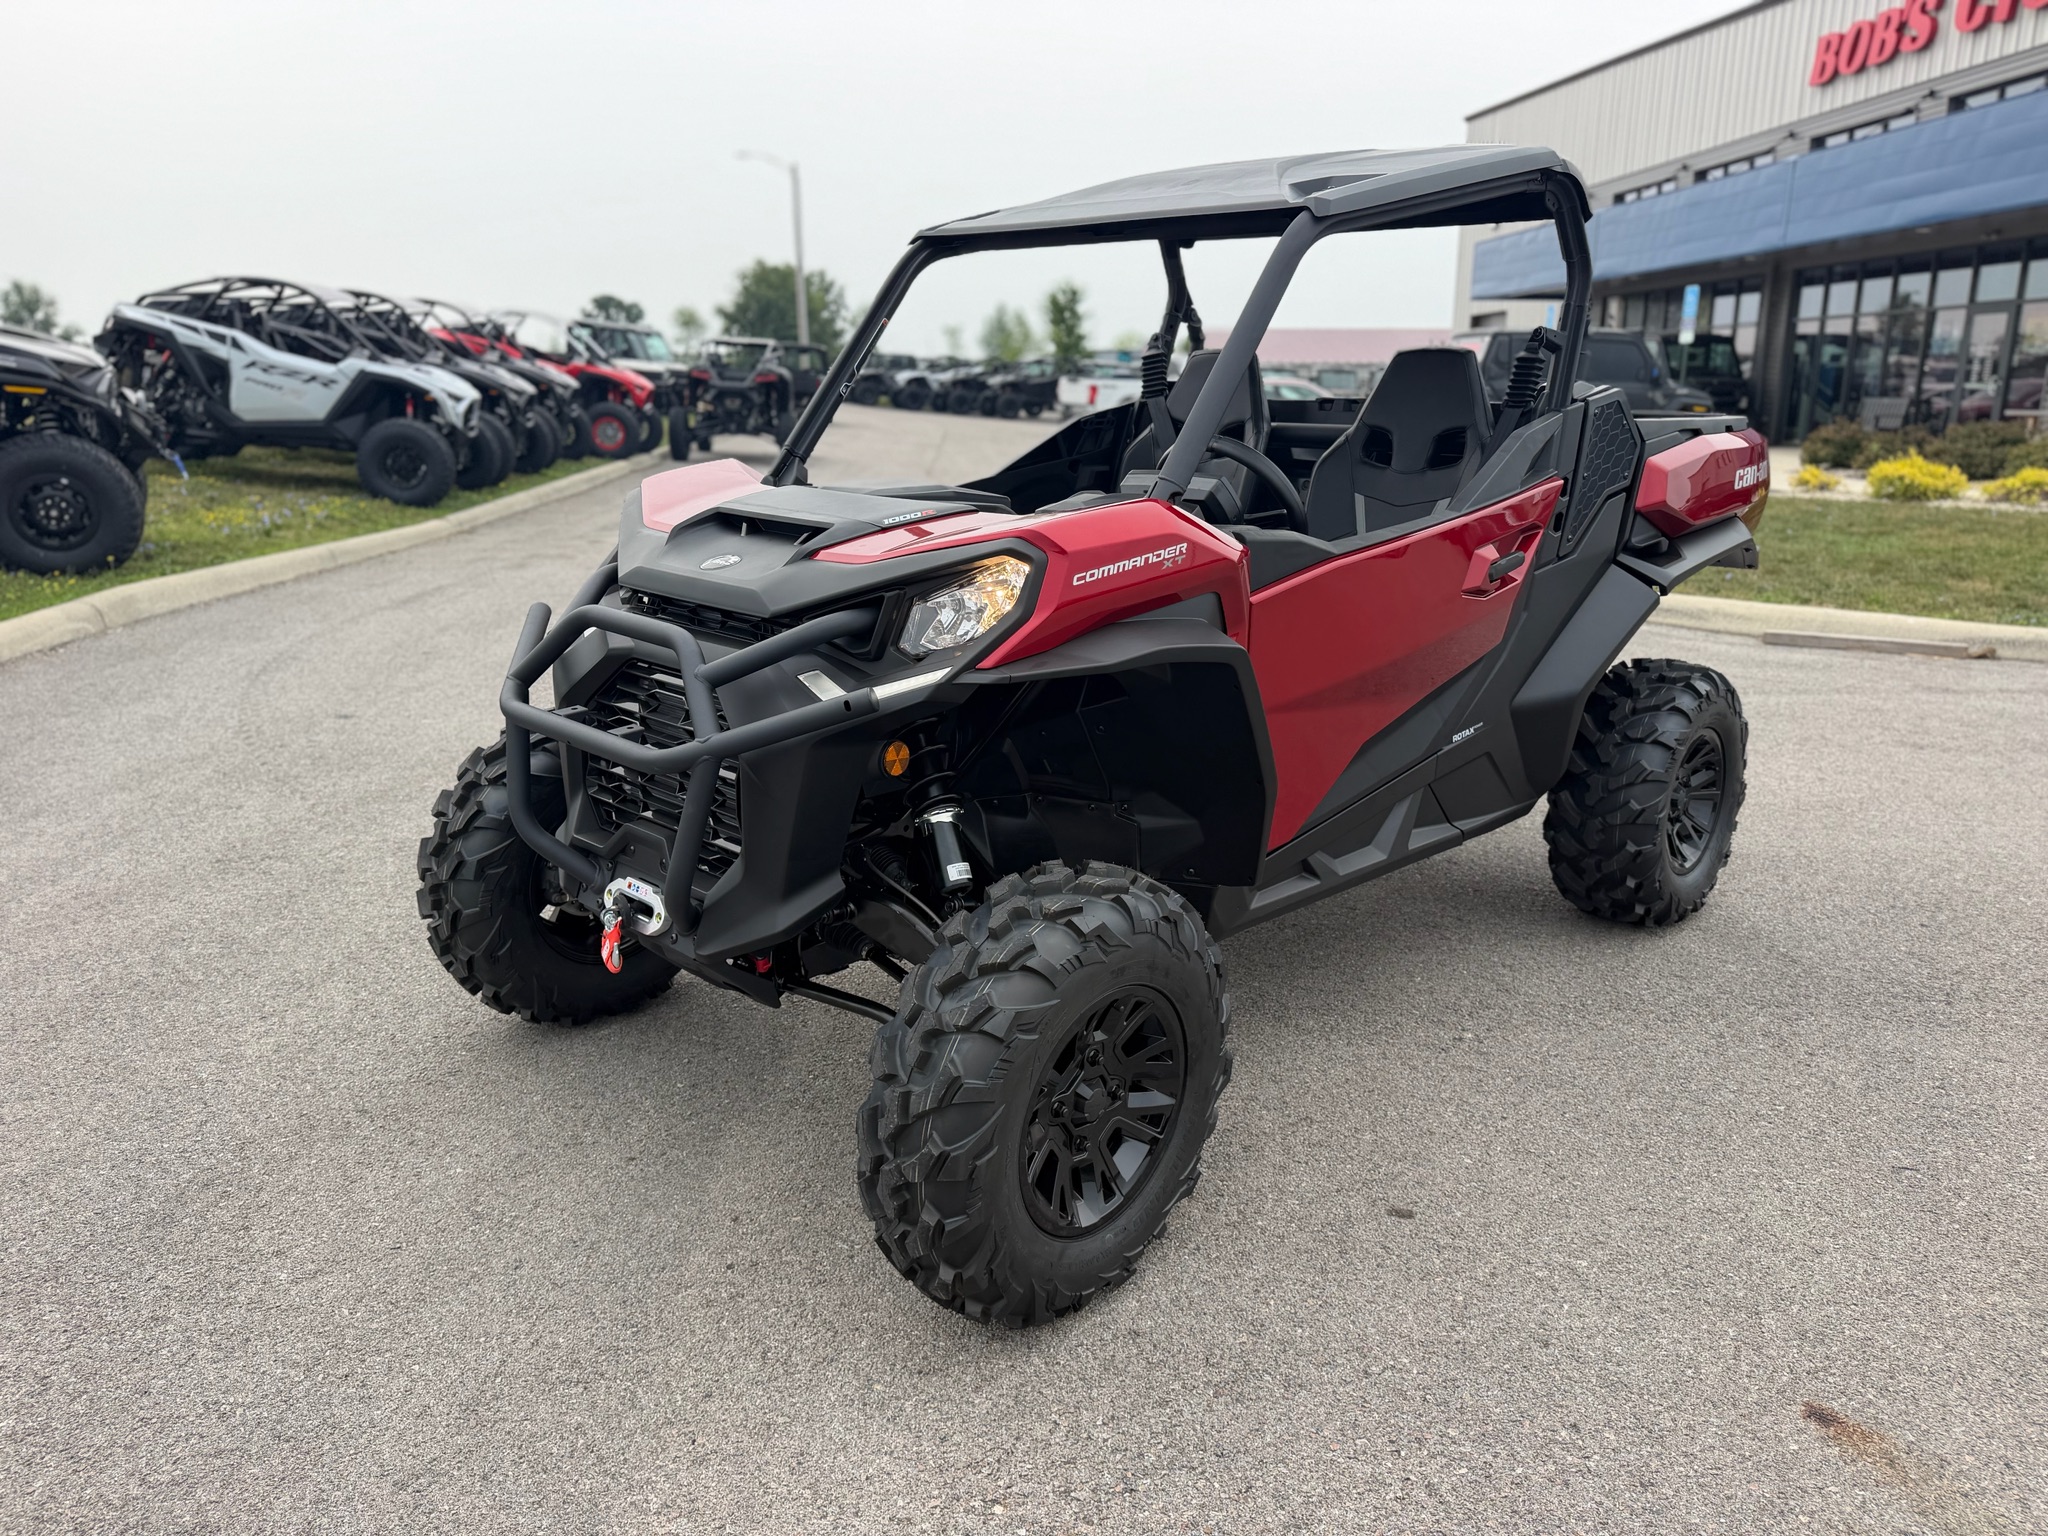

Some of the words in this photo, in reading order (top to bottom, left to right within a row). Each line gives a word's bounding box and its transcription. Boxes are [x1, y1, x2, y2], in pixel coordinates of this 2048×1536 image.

[1809, 0, 1944, 87] BOB'S
[882, 509, 937, 525] 1000R
[1072, 542, 1188, 586] COMMANDER
[1161, 555, 1186, 570] XT
[1452, 727, 1475, 743] ROTAX
